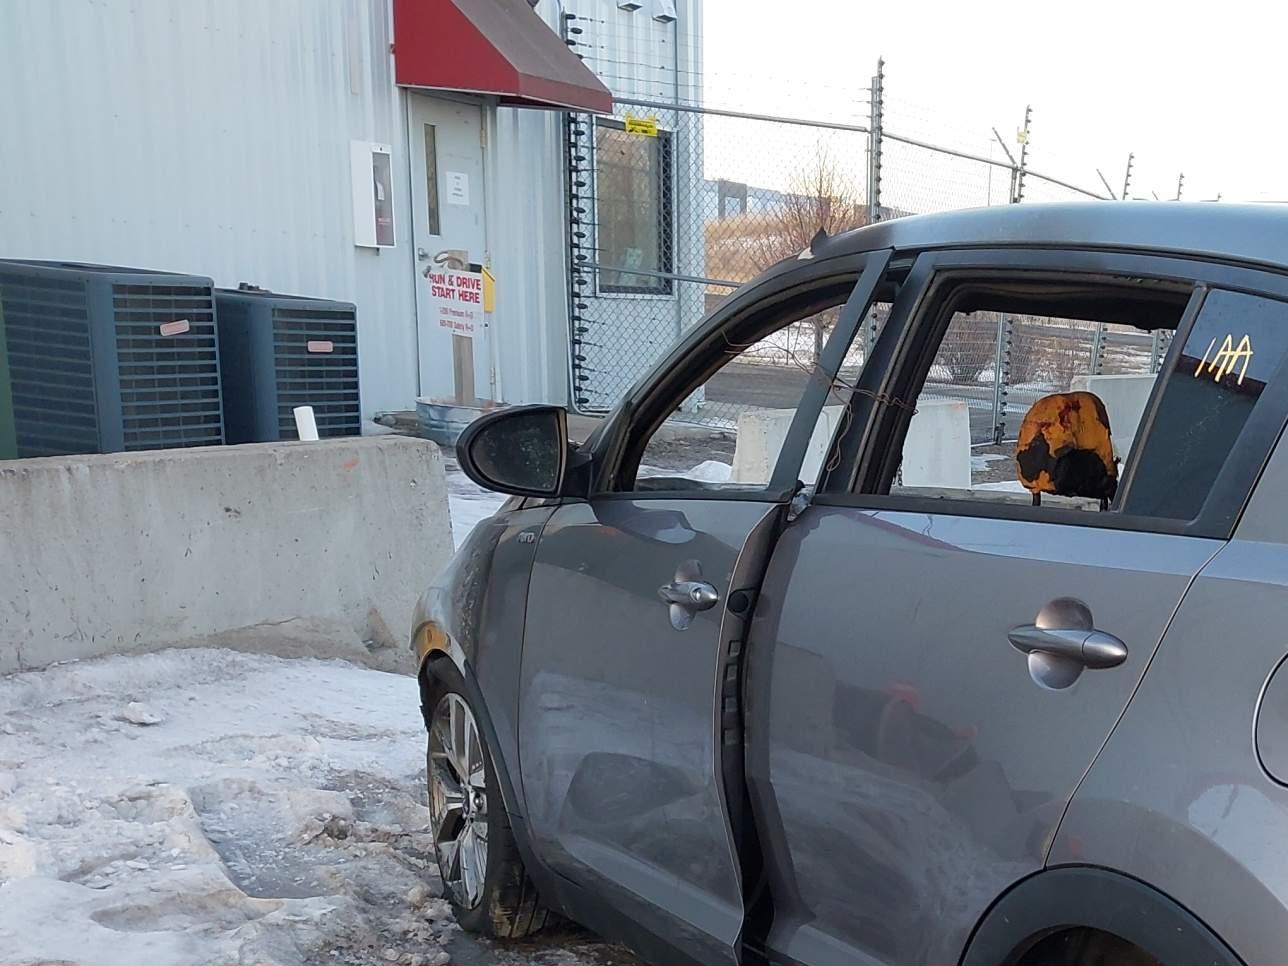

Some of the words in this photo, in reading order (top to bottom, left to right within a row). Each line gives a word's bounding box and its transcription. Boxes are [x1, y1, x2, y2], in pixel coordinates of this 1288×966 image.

[448, 275, 454, 286] &
[456, 276, 481, 290] DRIVE
[431, 286, 455, 300] START
[458, 289, 480, 304] HERE
[1194, 333, 1254, 386] IAA
